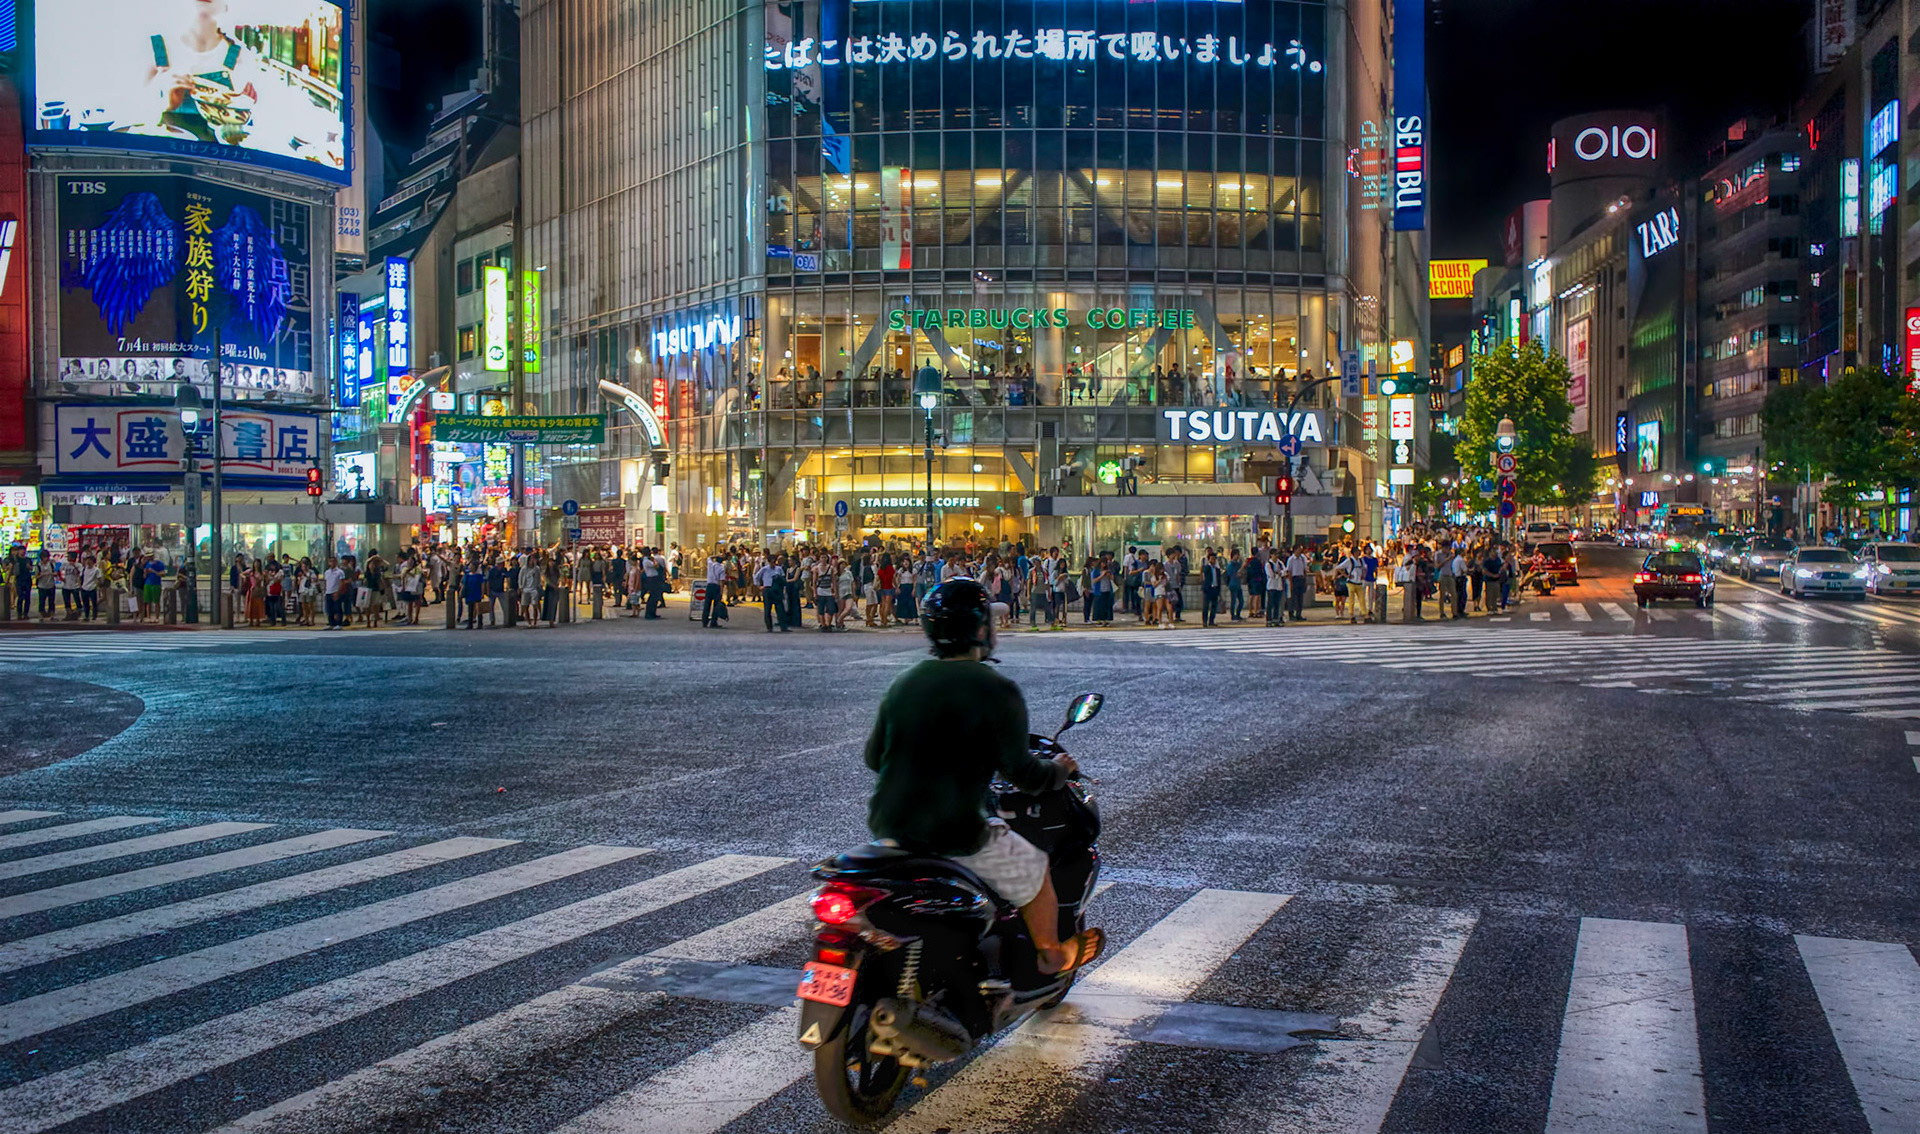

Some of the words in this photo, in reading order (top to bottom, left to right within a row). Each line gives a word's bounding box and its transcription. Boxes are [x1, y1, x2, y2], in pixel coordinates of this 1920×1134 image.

[1396, 115, 1422, 209] SEIBU
[67, 181, 107, 195] TBS
[339, 207, 359, 218] (03)
[338, 218, 360, 228] 3719
[338, 227, 360, 237] 2468
[1636, 206, 1680, 259] ZARA
[184, 203, 215, 335] 家族狩り
[1430, 263, 1471, 279] TOWER
[1429, 280, 1474, 297] RECORD
[888, 308, 1069, 330] STARBUCKS
[1086, 308, 1196, 330] COFFEE
[117, 337, 150, 352] 7月4日
[152, 342, 211, 354] 初回拡大スタート
[1163, 410, 1323, 442] TSUTAYA
[934, 497, 980, 508] COFFEE
